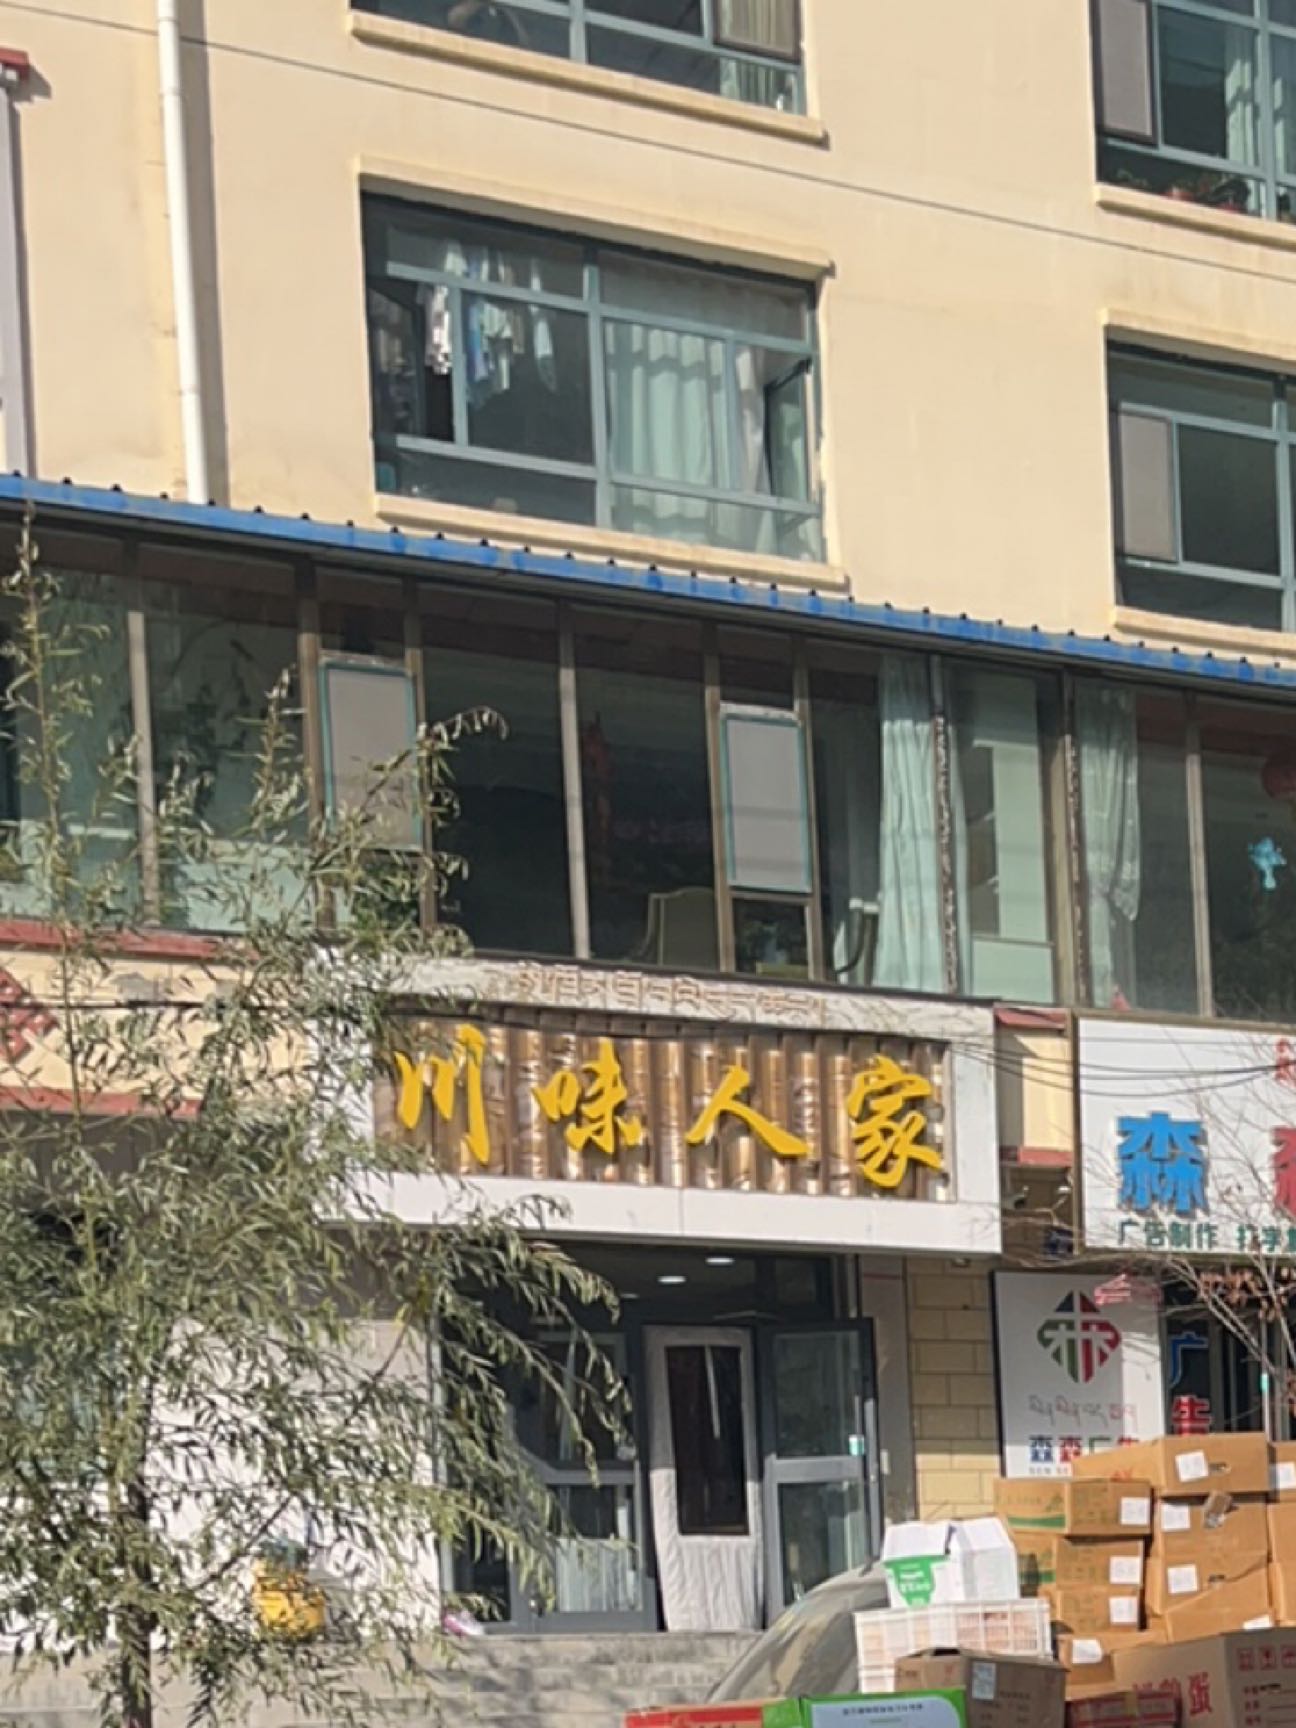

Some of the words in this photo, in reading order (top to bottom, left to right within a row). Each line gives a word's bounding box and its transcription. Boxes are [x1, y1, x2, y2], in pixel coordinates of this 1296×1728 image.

[394, 1023, 943, 1188] 川味人家
[1118, 1217, 1218, 1250] 广告制作
